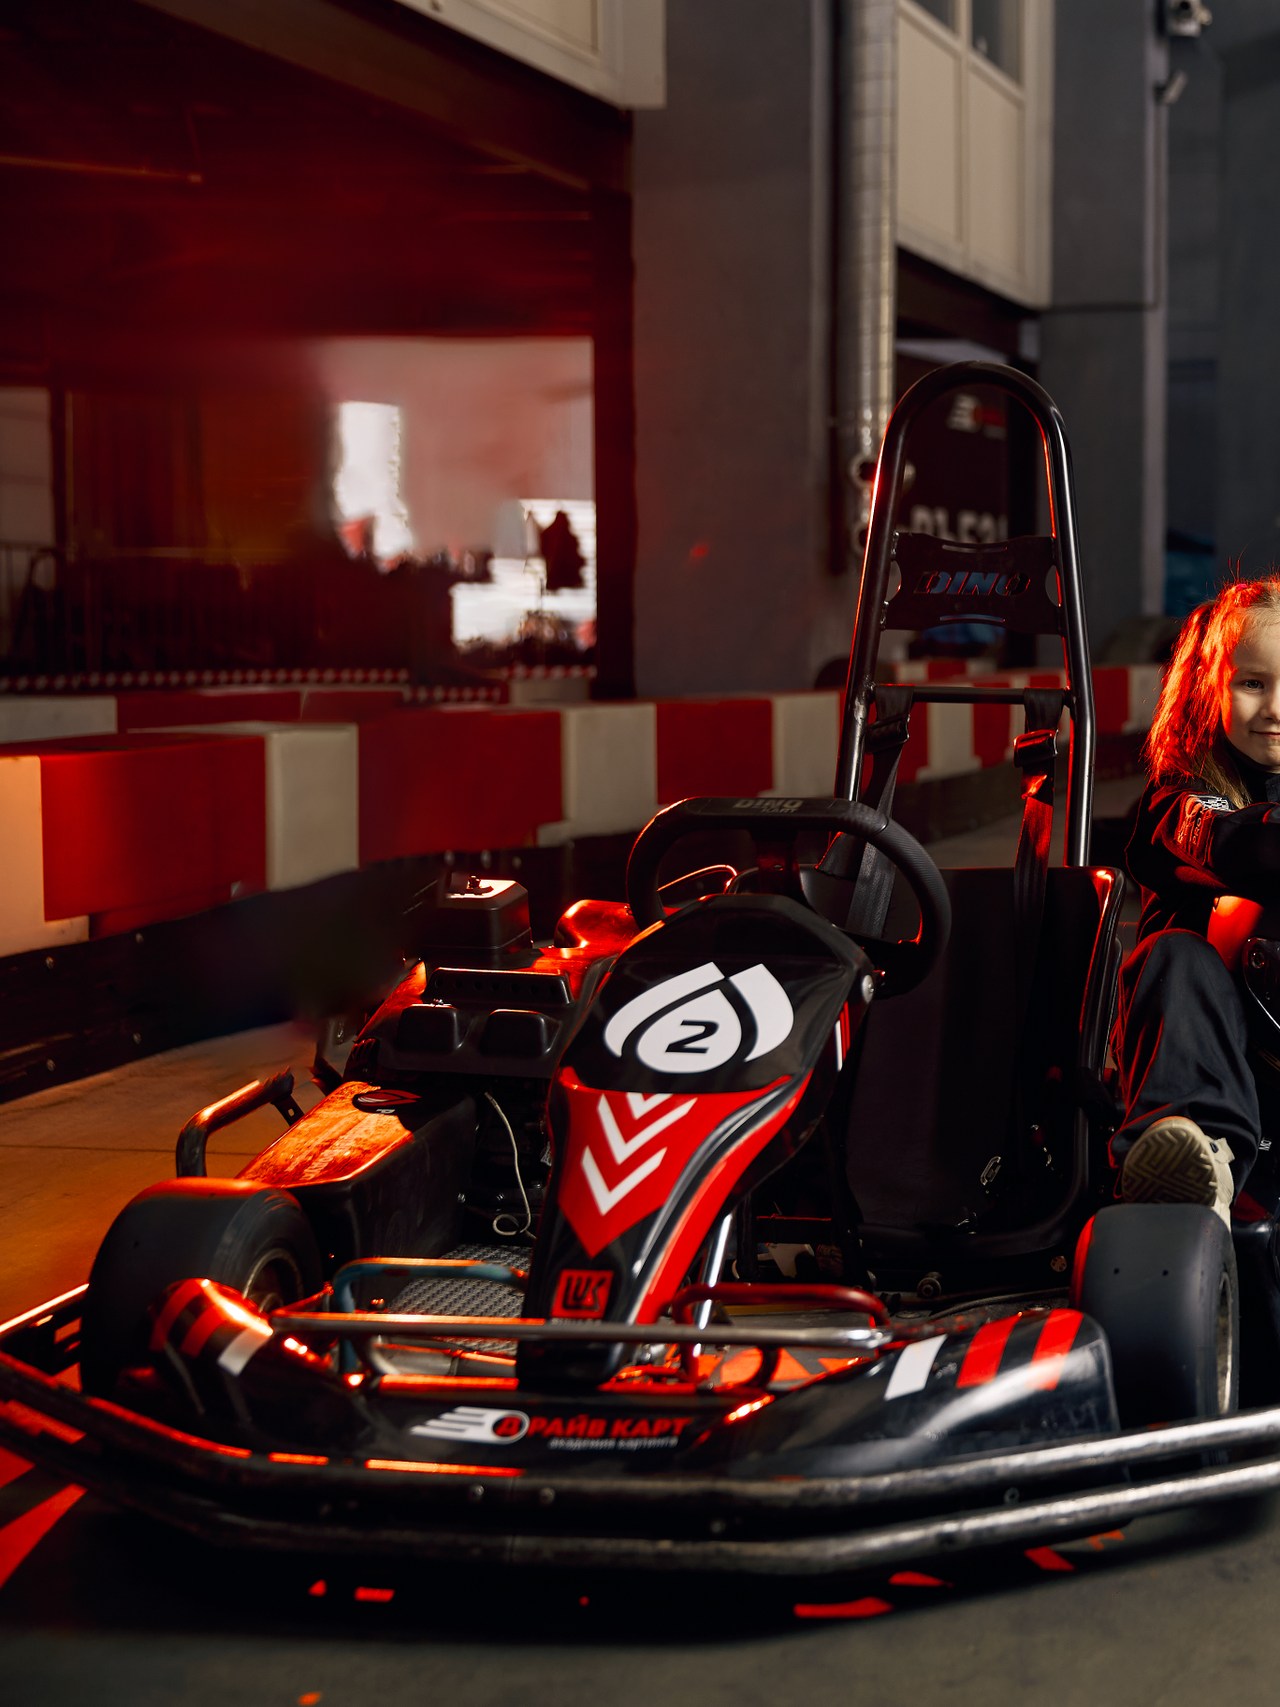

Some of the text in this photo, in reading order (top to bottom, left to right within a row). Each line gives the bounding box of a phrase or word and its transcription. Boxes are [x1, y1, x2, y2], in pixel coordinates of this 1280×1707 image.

[913, 570, 1032, 597] DINO
[732, 799, 804, 810] DINO
[665, 1019, 719, 1054] 2
[611, 1416, 695, 1439] КАРТ
